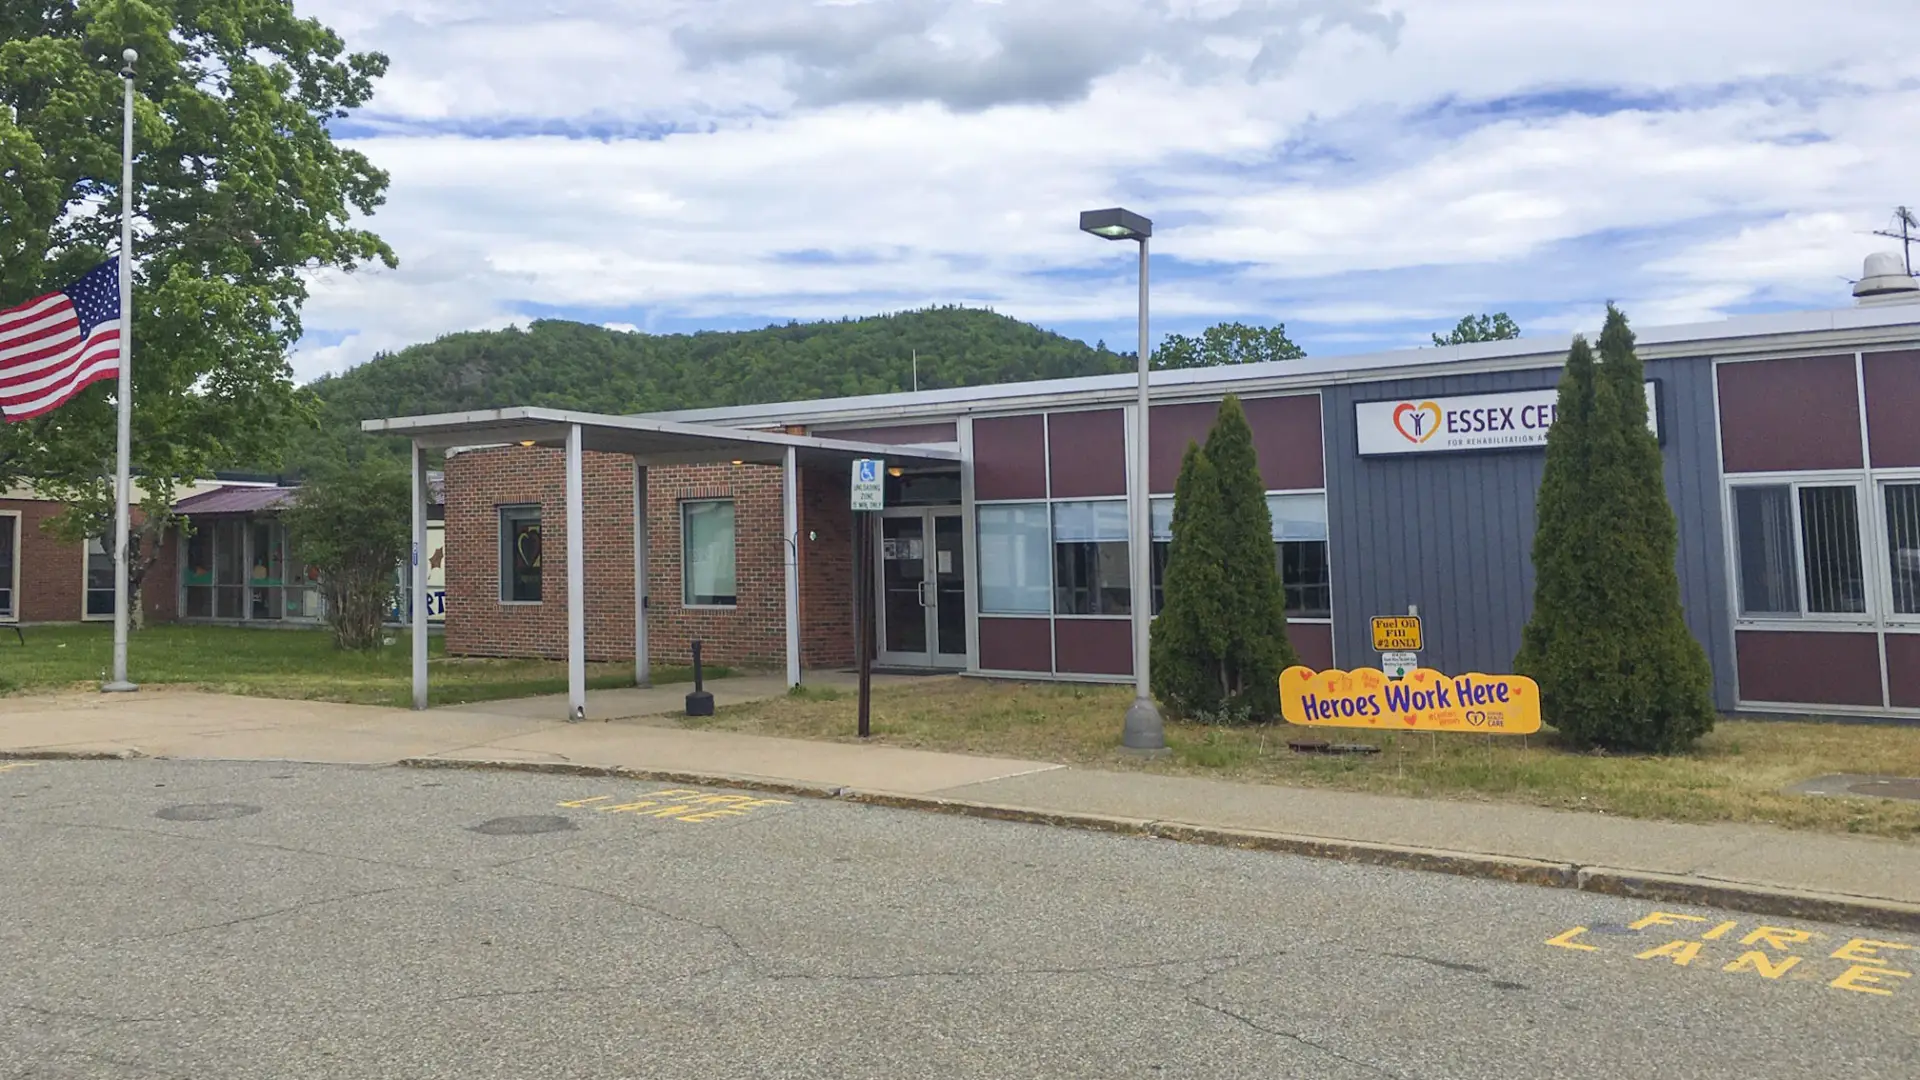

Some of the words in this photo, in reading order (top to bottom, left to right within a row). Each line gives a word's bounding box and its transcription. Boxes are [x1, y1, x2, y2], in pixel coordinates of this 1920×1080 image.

[1447, 407, 1515, 433] ESSEX
[1447, 439, 1463, 447] FOR
[1467, 435, 1534, 445] REHABILITATION
[1376, 618, 1398, 628] Fuel
[1401, 619, 1416, 628] Oil
[1377, 639, 1389, 648] #2
[1391, 638, 1418, 648] ONLY
[1301, 693, 1380, 721] Heroes
[1384, 680, 1451, 714] Work
[1455, 678, 1510, 708] Here
[1629, 911, 1913, 965] FIRE
[1544, 925, 1913, 997] LANE
